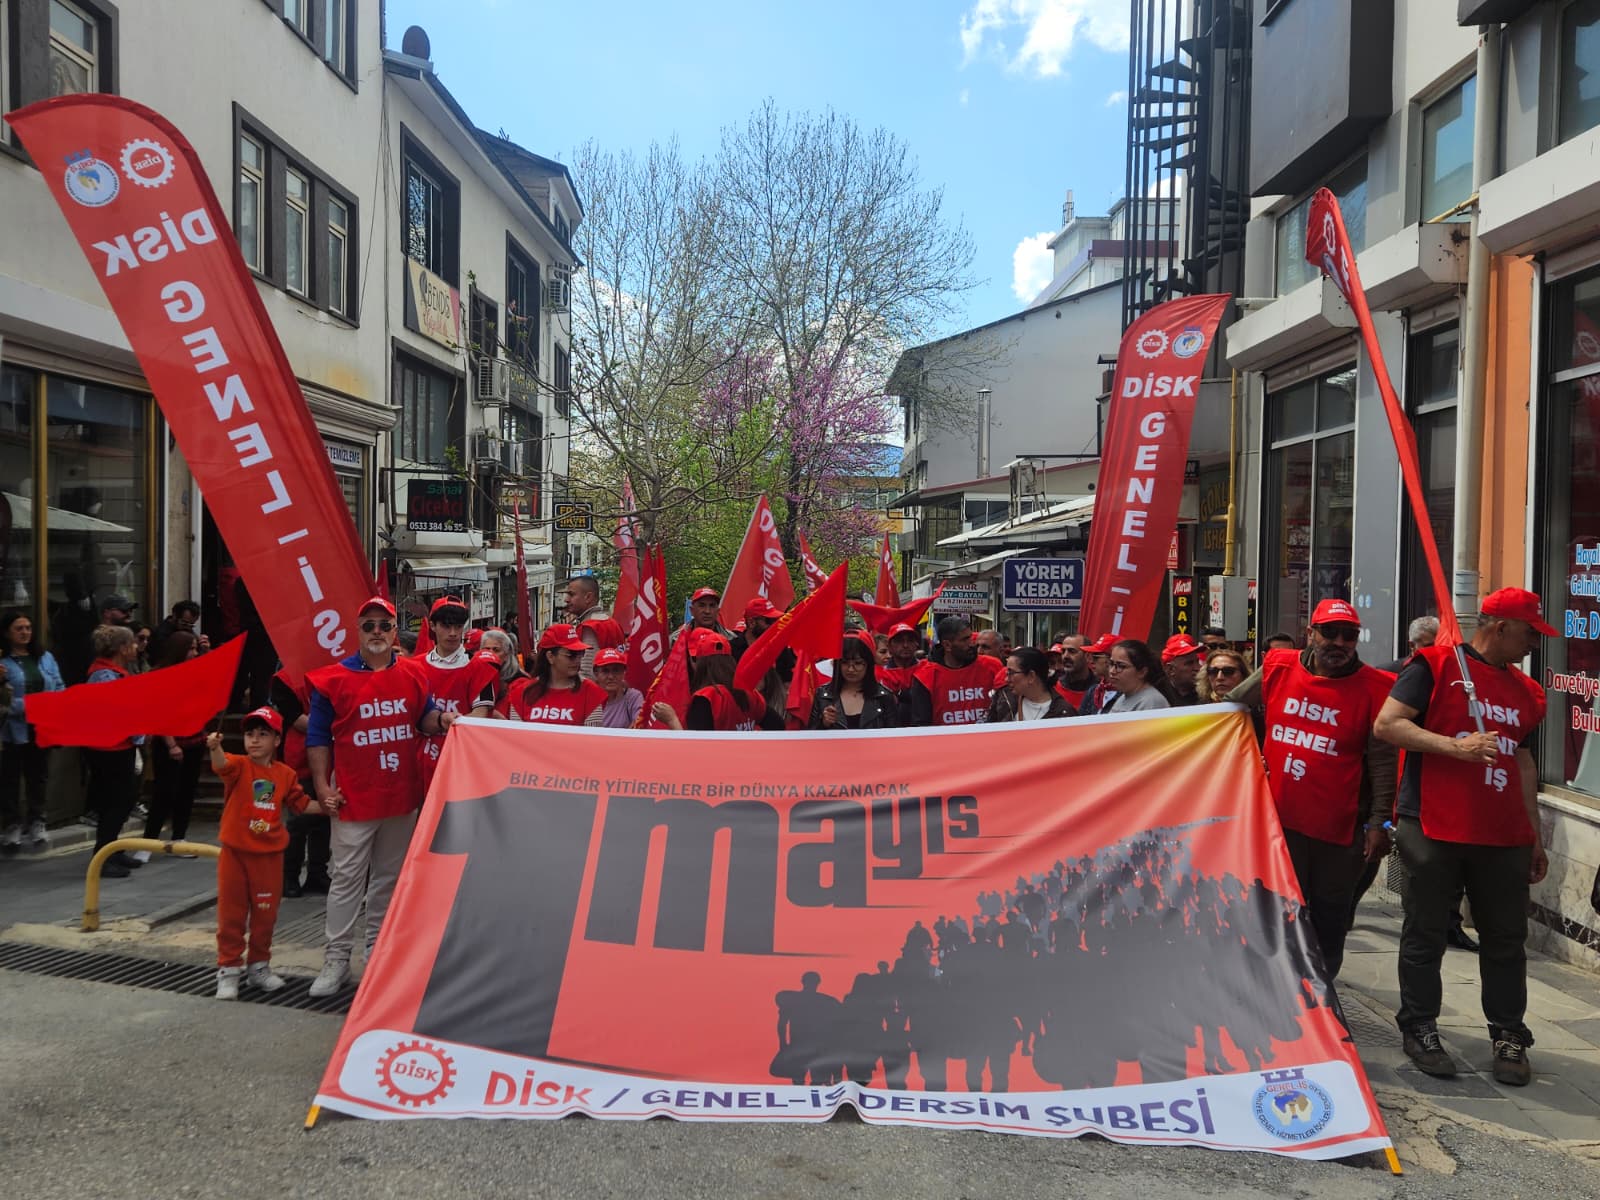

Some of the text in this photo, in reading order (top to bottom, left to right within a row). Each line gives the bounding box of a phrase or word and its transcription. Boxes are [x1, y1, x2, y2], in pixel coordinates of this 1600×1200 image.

[1122, 372, 1198, 398] DİSK
[1014, 562, 1074, 580] YÖREM
[1015, 582, 1073, 597] KEBAP
[1564, 609, 1588, 639] Biz
[949, 686, 984, 702] DİSK
[1546, 667, 1600, 703] Davetiye
[359, 698, 408, 719] DİSK
[529, 705, 575, 721] DİSK
[943, 708, 985, 724] GENE
[1283, 697, 1341, 727] DİSK
[353, 723, 414, 747] GENEL
[1271, 724, 1338, 757] GENEL
[379, 750, 399, 772] İŞ
[424, 738, 439, 760] İŞ
[1283, 753, 1307, 781] İŞ
[1484, 763, 1508, 792] İŞ
[509, 772, 911, 798] BİR ZİNCİR YİTİRENLER BİR DÜNYA KAZANACAK
[415, 786, 599, 1057] 1
[394, 1059, 439, 1082] DİSK
[483, 1070, 593, 1107] DİSK
[858, 1092, 1031, 1121] DERSİM
[1044, 1088, 1216, 1135] ŞUBESİ
